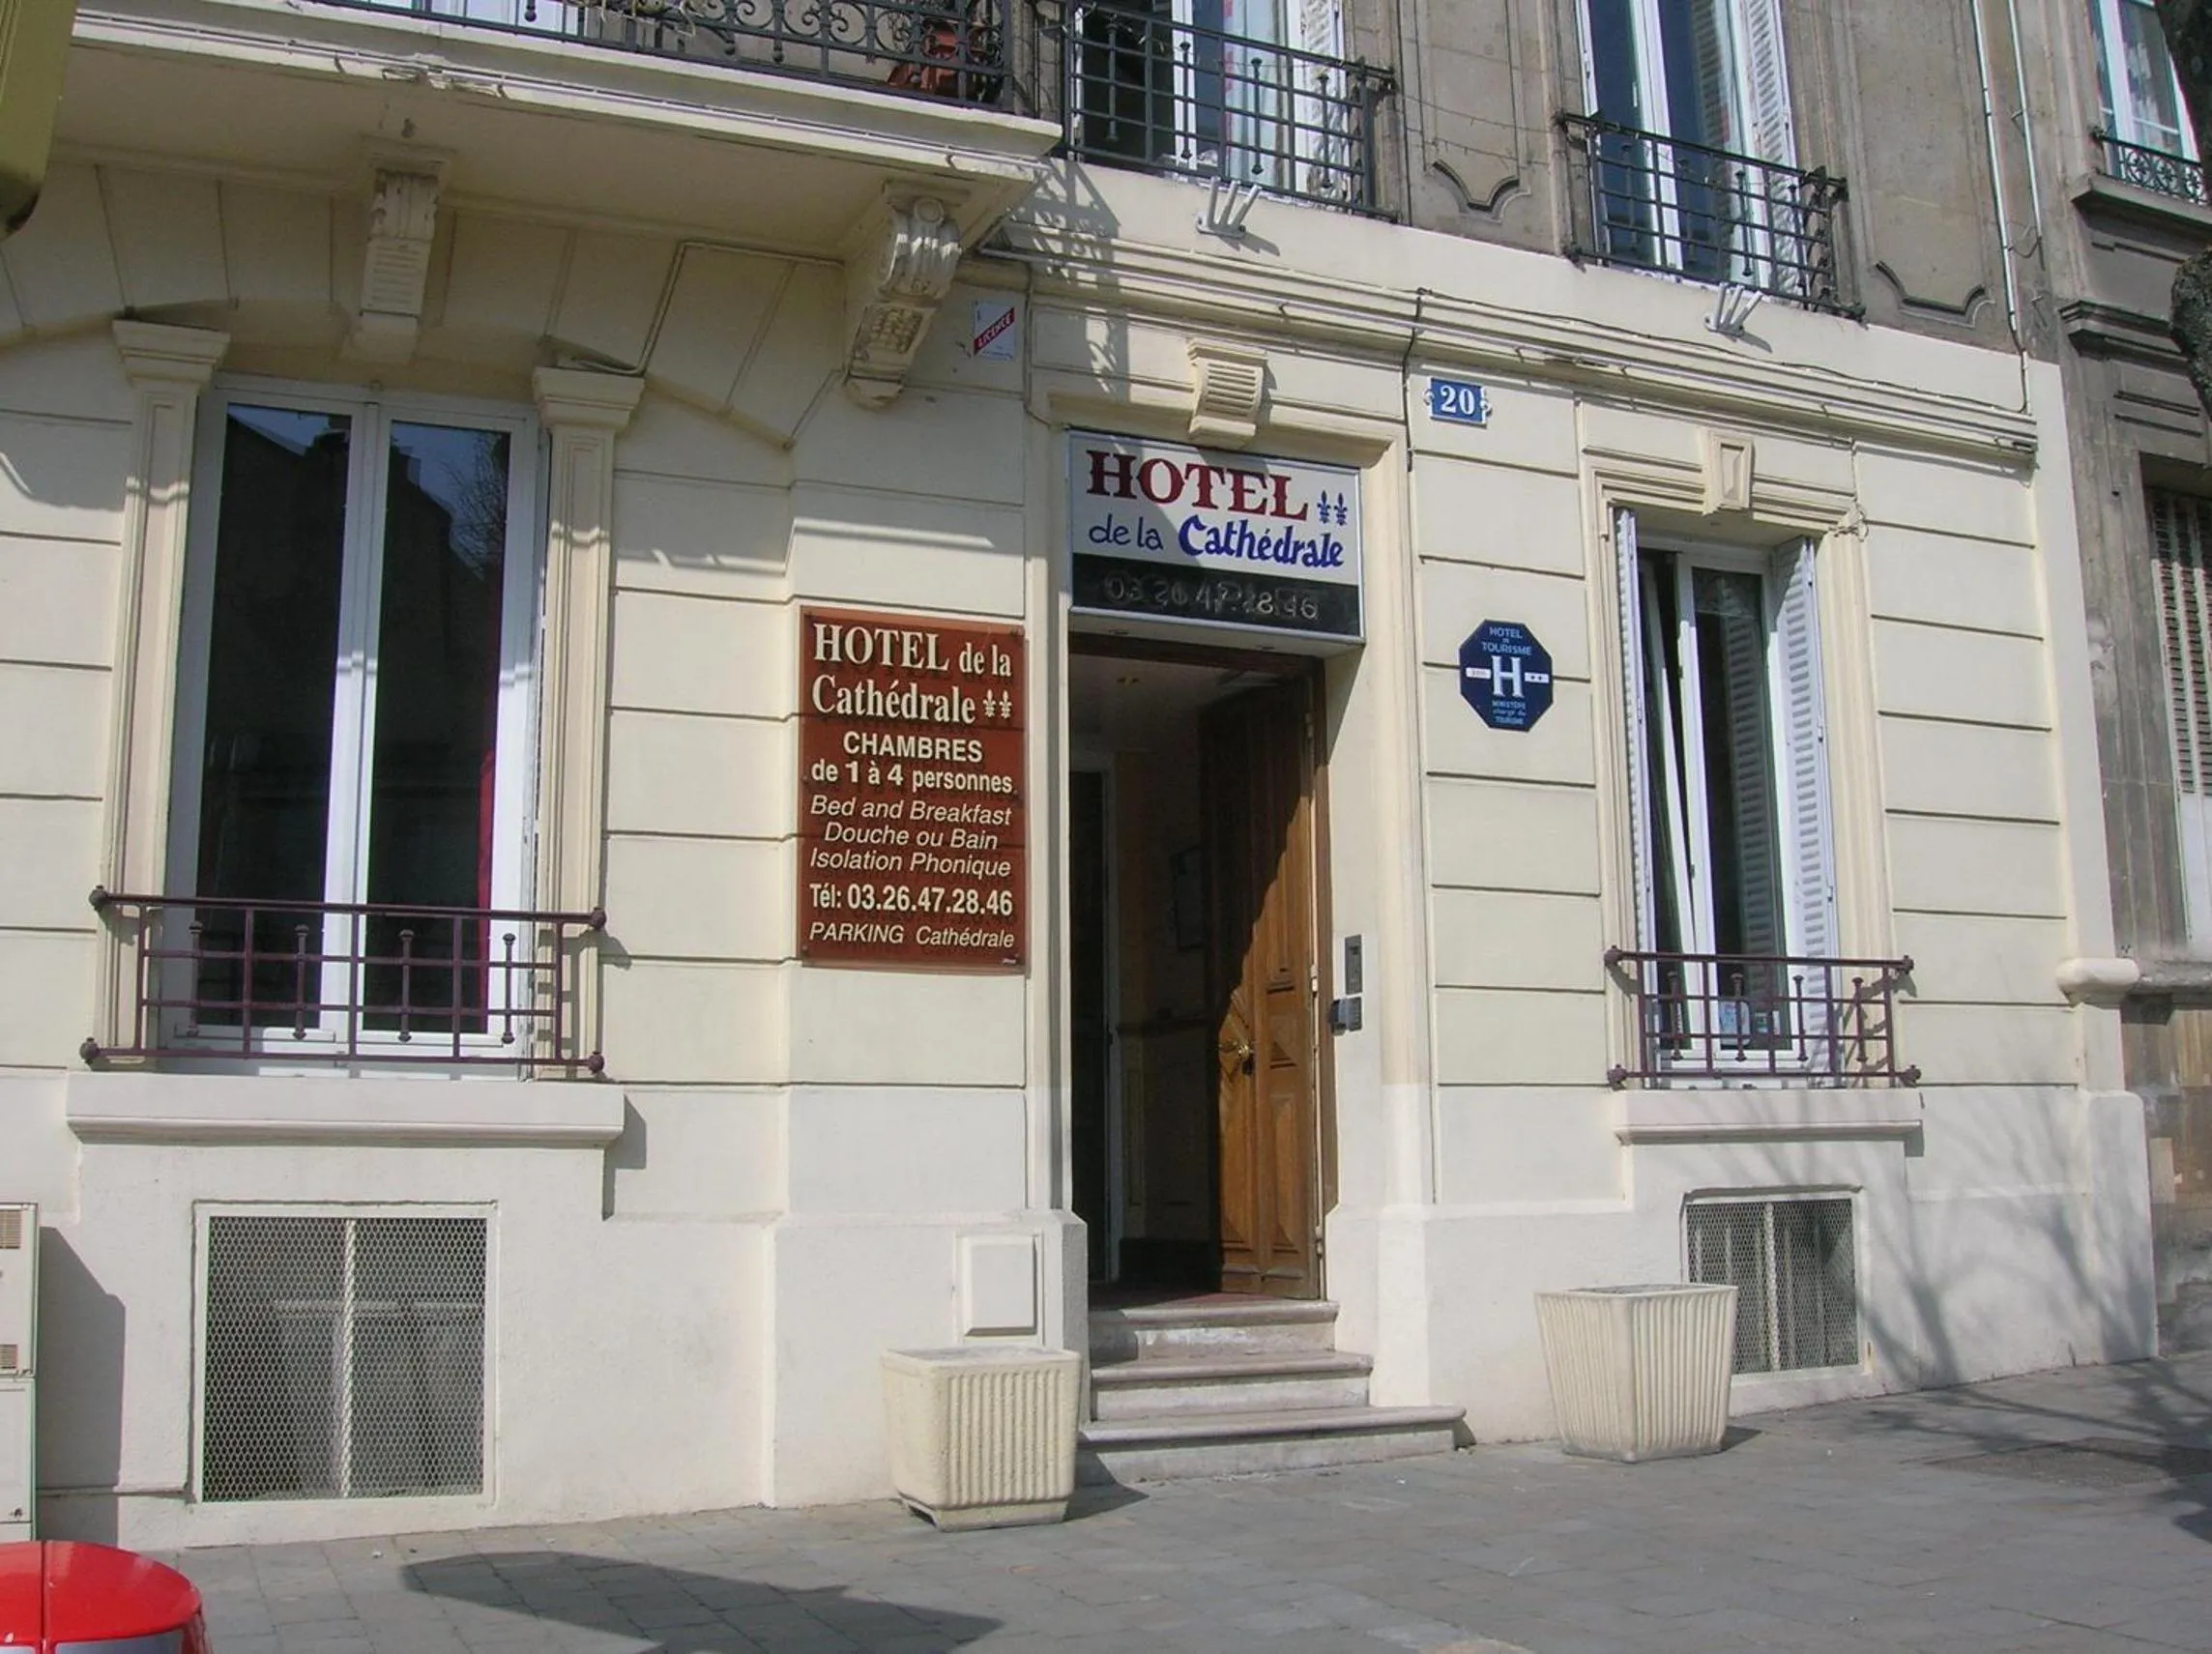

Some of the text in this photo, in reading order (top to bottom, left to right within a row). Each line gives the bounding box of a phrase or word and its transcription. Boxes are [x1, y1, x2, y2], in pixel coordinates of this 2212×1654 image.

[1440, 385, 1475, 415] 20
[1086, 450, 1309, 521] HOTEL
[1089, 513, 1345, 568] de la Cathédrale
[1481, 641, 1532, 655] TOURISME
[1489, 626, 1524, 639] HOTEL
[813, 624, 1011, 677] HOTEL de la
[1491, 655, 1524, 697] H
[812, 674, 976, 724] Cathédrale
[843, 731, 983, 763] CHAMBRES
[811, 759, 1013, 794] de 1 à 4 personnes
[810, 794, 1012, 826] Bed and Breakfast
[825, 822, 999, 850] Douche ou Bain
[810, 848, 1011, 880] Isolation Phonique
[809, 883, 1013, 916] Tél: 03.26.47.28.46
[809, 922, 1015, 947] PARKING Cathédrale
